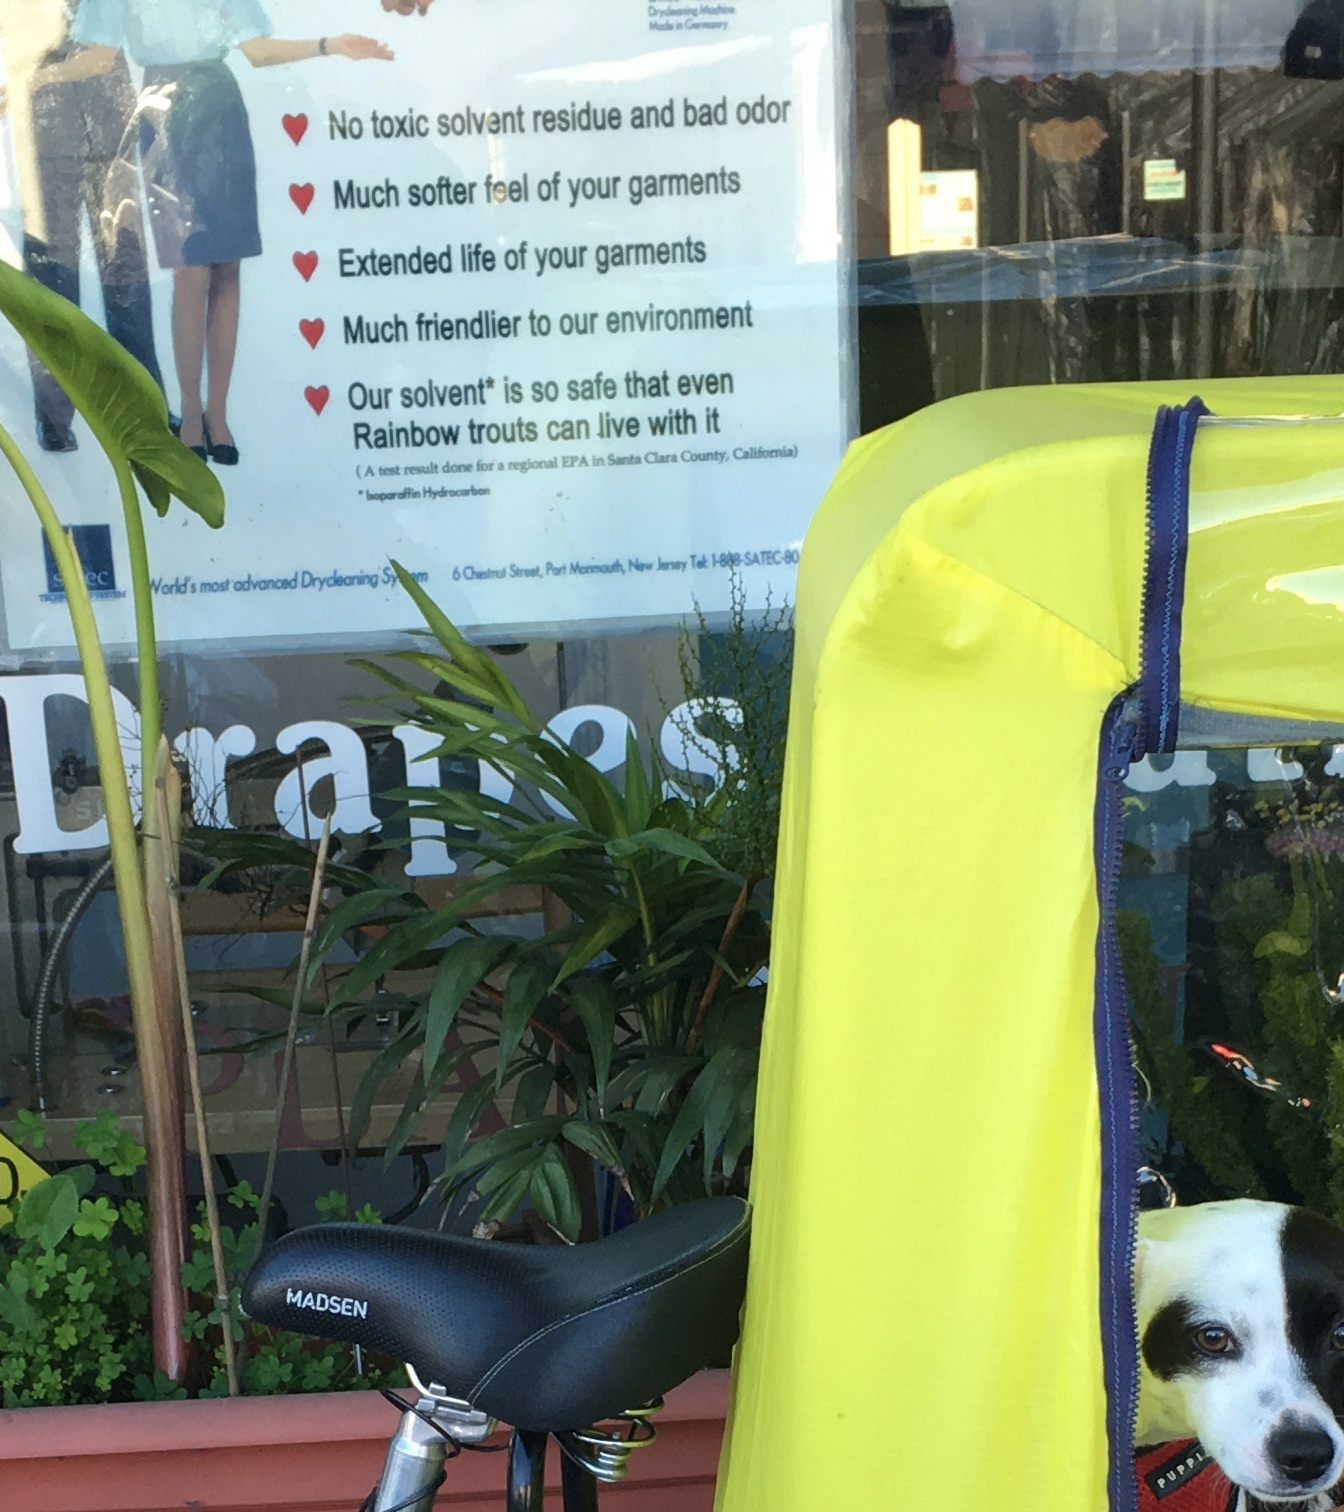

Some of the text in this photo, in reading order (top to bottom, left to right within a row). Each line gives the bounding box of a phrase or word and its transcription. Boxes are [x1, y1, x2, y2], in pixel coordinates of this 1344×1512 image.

[328, 94, 792, 140] No toxic solvent residue and bad odor
[333, 166, 741, 209] Much softer feel of your garments
[339, 235, 707, 278] Extended life of your garments
[343, 300, 754, 344] Much friendlier to our environment
[348, 382, 393, 410] Our
[504, 375, 524, 404] is
[531, 381, 559, 403] so
[567, 371, 617, 401] safe
[625, 369, 670, 399] that
[677, 372, 734, 396] even
[353, 407, 720, 450] Rainbow trouts can live with it
[364, 465, 375, 477] A
[378, 464, 400, 476] test
[404, 461, 439, 476] result
[442, 461, 473, 473] done
[476, 459, 494, 472] for
[497, 462, 505, 471] a
[508, 456, 557, 473] regional
[561, 456, 587, 468] EPA
[592, 454, 606, 467] in
[607, 453, 642, 466] Santa
[644, 451, 678, 464] Clara
[680, 450, 730, 466] County,
[733, 445, 799, 460] California)
[423, 484, 491, 499] Hydrocarbon
[150, 566, 429, 595] World's most advanced Drycleaning Syem
[452, 566, 461, 581] 6
[463, 565, 506, 580] Chestnut
[629, 557, 653, 572] New
[656, 557, 687, 573] Jersey
[286, 1286, 369, 1320] MADSEN
